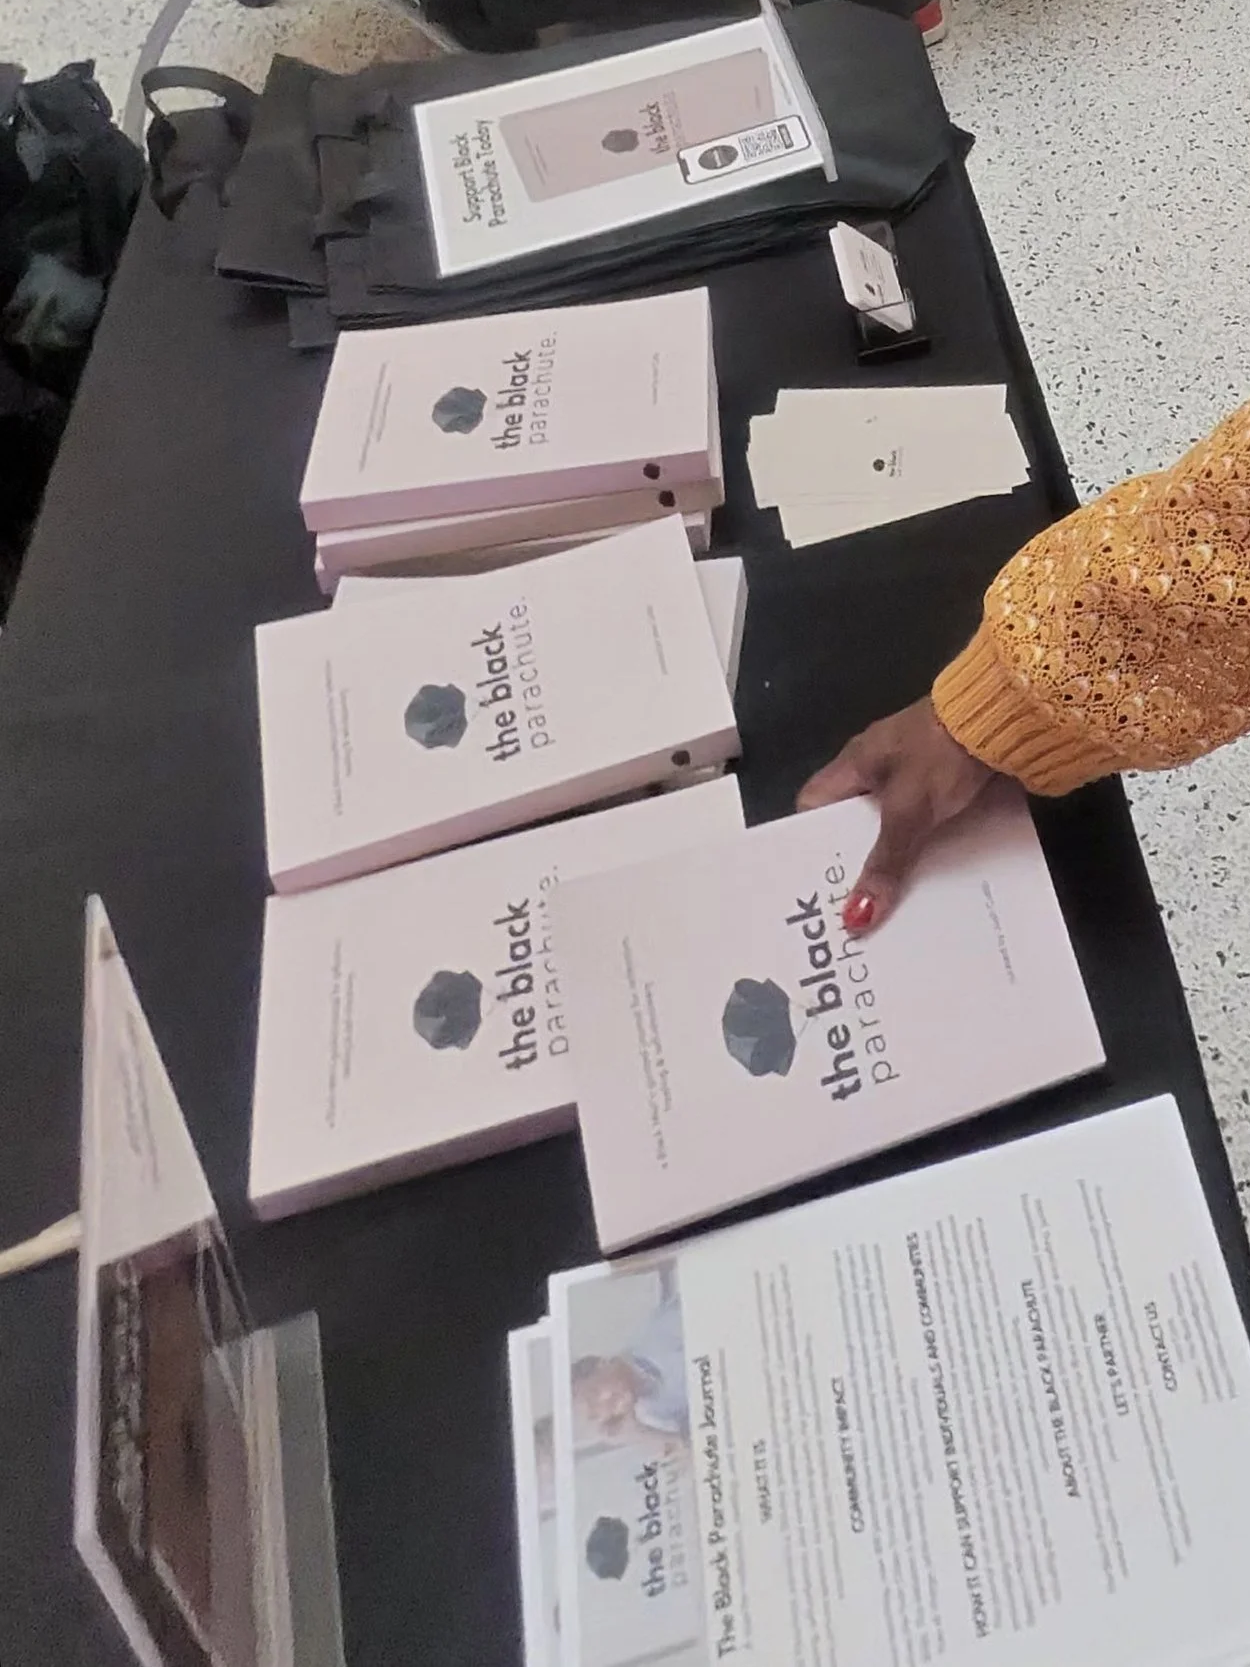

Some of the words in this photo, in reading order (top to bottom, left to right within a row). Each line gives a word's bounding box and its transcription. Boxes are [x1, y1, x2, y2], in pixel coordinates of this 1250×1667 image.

[449, 132, 472, 168] Black
[471, 120, 496, 159] Today
[458, 168, 485, 223] Support
[478, 160, 508, 228] Parachute
[495, 349, 532, 409] black
[529, 331, 557, 445] parachute.
[490, 413, 523, 449] the
[469, 620, 513, 708] black
[509, 595, 557, 750] parachute.
[485, 709, 521, 762] the
[493, 898, 534, 1002] black
[785, 890, 843, 1018] black
[825, 852, 901, 1085] parachte.
[498, 1005, 538, 1070] the
[819, 1023, 863, 1102] the
[906, 1232, 933, 1327] COMMUNITIES
[1144, 1301, 1159, 1322] US
[923, 1329, 939, 1360] AND
[1021, 1278, 1049, 1363] PARACHUTE
[1094, 1314, 1119, 1378] PARTNER
[1040, 1366, 1062, 1413] BLACK
[1148, 1322, 1178, 1393] CONTACT
[692, 1354, 716, 1430] Journal
[831, 1376, 849, 1432] IMPACT
[929, 1362, 957, 1456] INDIVIDUALS
[1050, 1416, 1068, 1444] THE
[635, 1460, 664, 1545] black
[703, 1434, 727, 1545] Parachute
[839, 1436, 866, 1534] COMMUNITY
[946, 1460, 971, 1531] SUPPORT
[1058, 1446, 1081, 1498] ABOUT
[640, 1546, 667, 1599] the
[711, 1550, 733, 1612] Black
[959, 1533, 977, 1571] CAN
[717, 1613, 735, 1660] The
